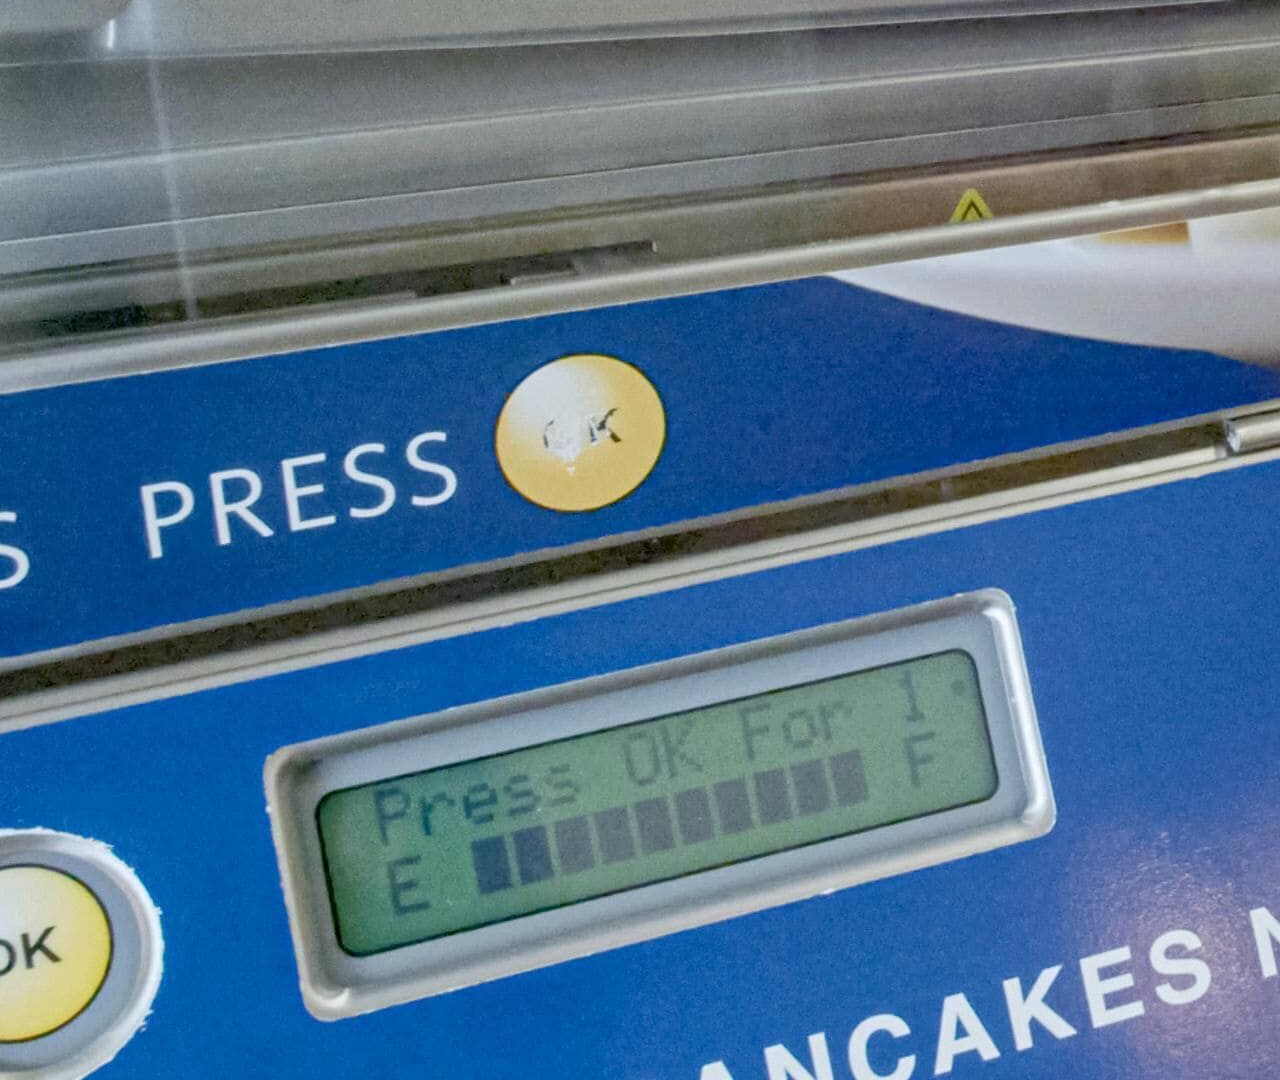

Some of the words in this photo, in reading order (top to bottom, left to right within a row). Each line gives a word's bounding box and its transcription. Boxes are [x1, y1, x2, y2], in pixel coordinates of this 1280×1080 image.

[140, 431, 458, 558] PRESS
[542, 407, 622, 450] K
[373, 762, 580, 846] Press
[620, 727, 704, 788] OK
[736, 696, 853, 761] For
[901, 730, 936, 788] F
[385, 854, 430, 916] E
